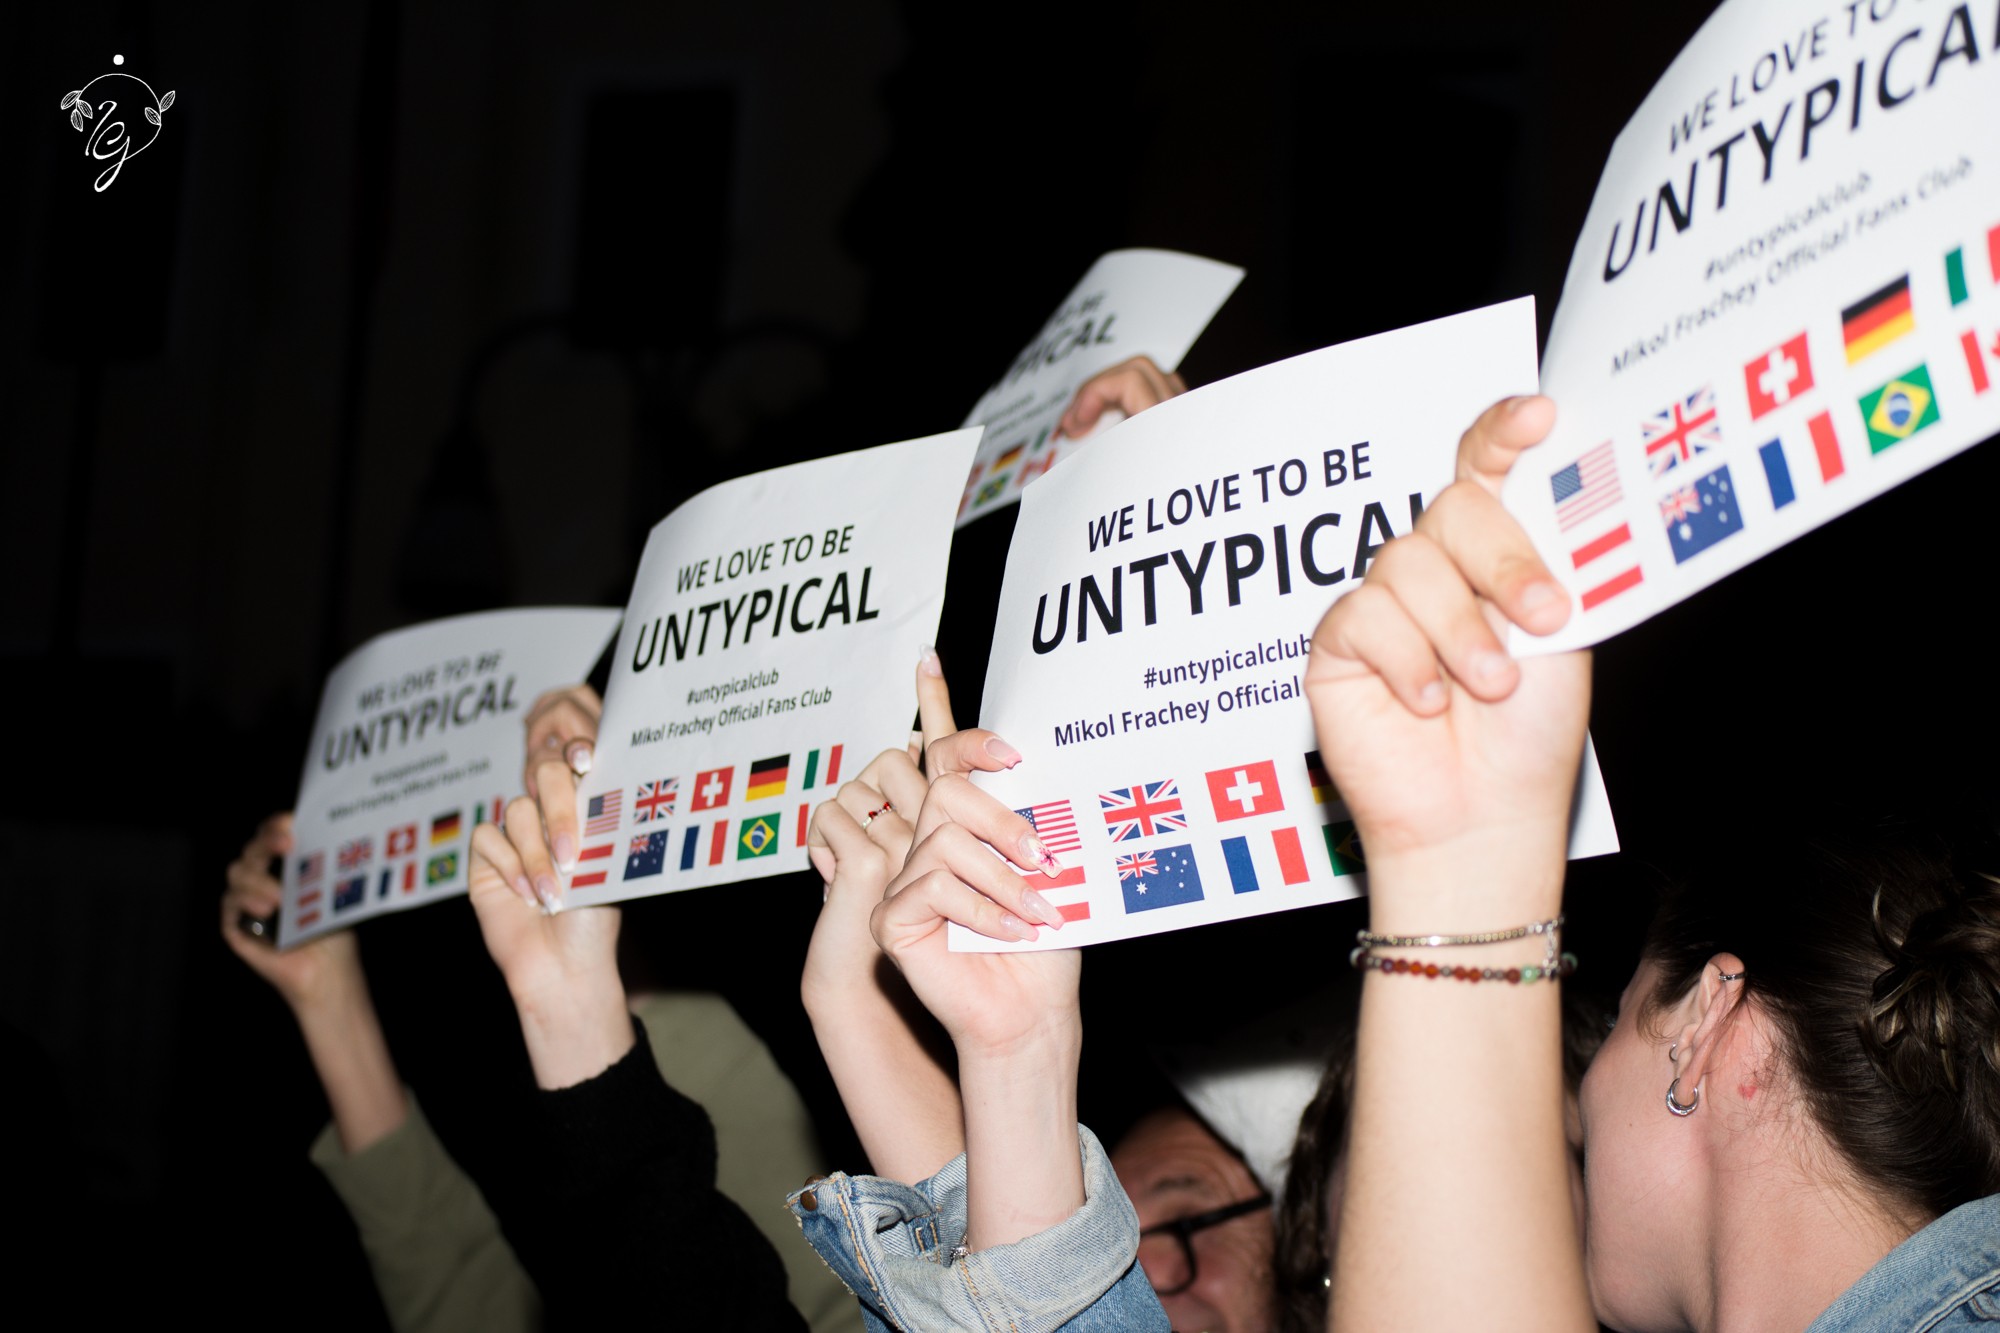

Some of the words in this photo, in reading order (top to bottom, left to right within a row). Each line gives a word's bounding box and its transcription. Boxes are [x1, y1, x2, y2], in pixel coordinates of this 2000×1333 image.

[1670, 88, 1719, 154] WE
[1730, 18, 1829, 109] LOVE
[1603, 0, 2000, 283] UNTYPICA
[1088, 504, 1135, 553] WE
[1146, 473, 1241, 533] LOVE
[1252, 458, 1307, 503] TO
[1323, 440, 1372, 488] BE
[676, 559, 710, 594] WE
[714, 542, 774, 583] LOVE
[782, 533, 814, 567] TO
[821, 525, 855, 558] BE
[632, 566, 880, 673] UNTYPICAL
[323, 673, 518, 772] UNTYPICAL
[631, 724, 665, 748] Mikol
[667, 714, 715, 740] Frachey
[718, 701, 764, 727] Official
[767, 695, 796, 716] Fans
[801, 686, 832, 708] Club
[686, 667, 779, 706] #untypicalclub
[1054, 713, 1115, 747] Mikol
[1121, 699, 1210, 733] Frachey
[1217, 675, 1301, 713] Official
